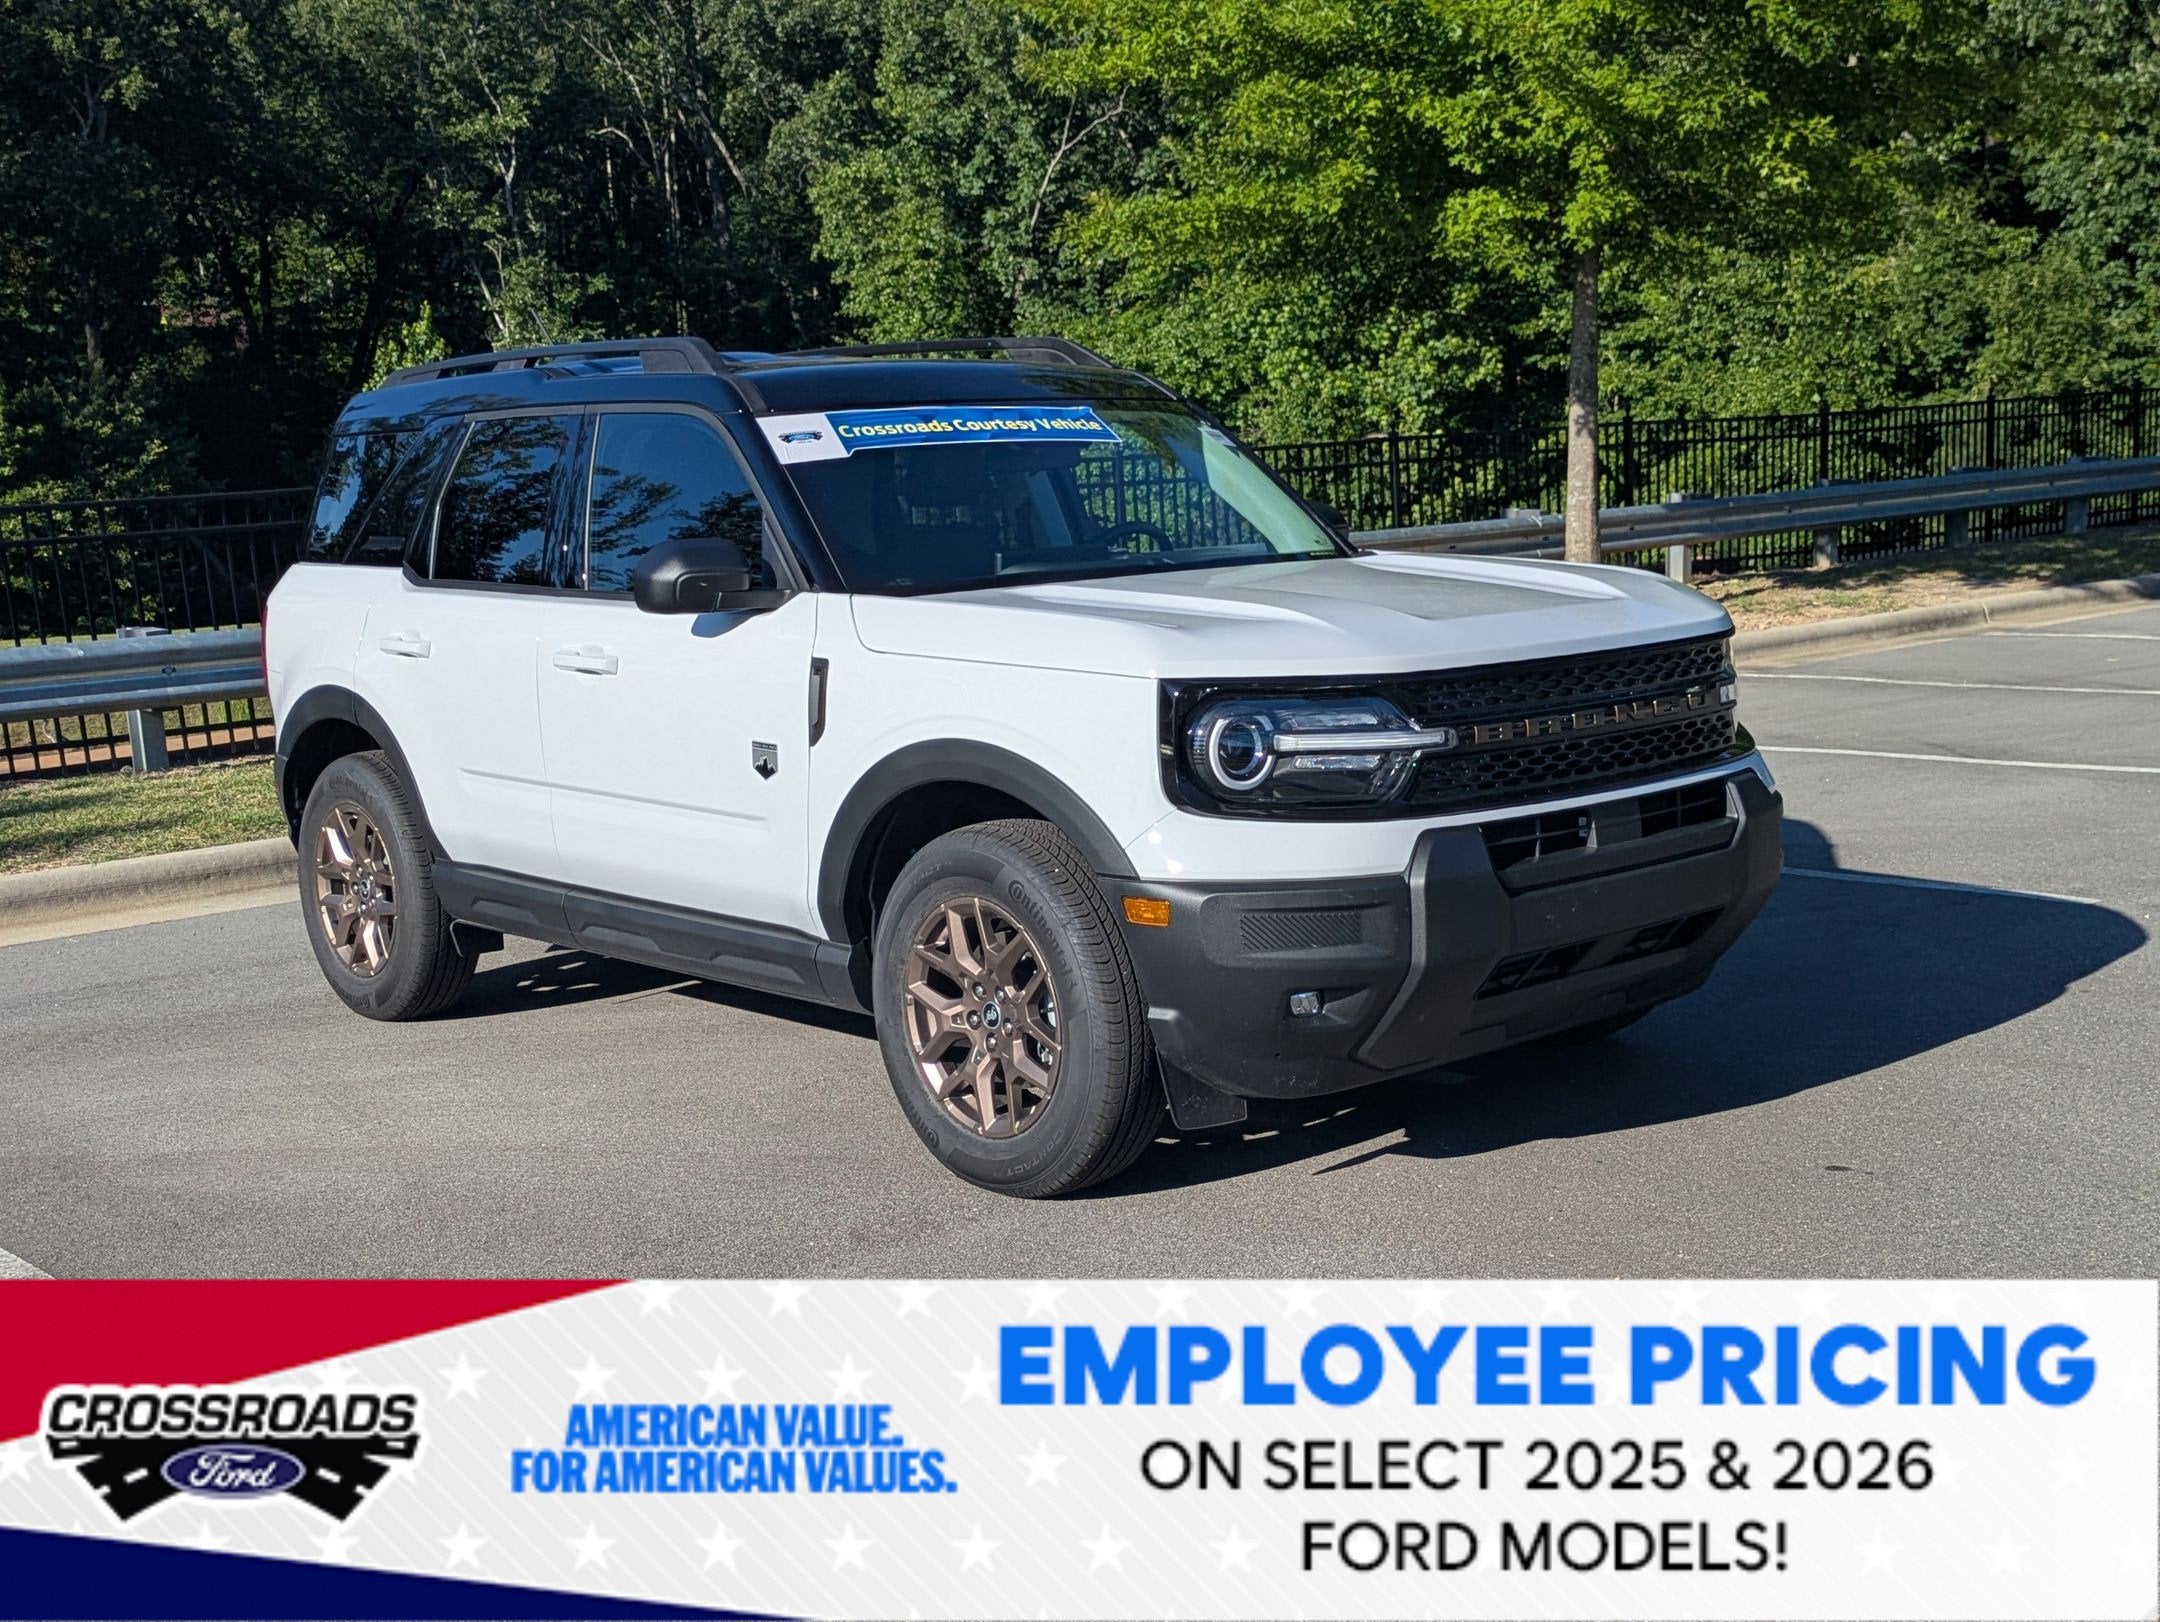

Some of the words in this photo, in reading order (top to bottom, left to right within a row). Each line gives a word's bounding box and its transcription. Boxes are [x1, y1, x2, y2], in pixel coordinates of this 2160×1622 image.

[837, 420, 954, 438] Crossroads
[952, 418, 1038, 432] Courtesy
[1034, 417, 1103, 431] Vehicle
[1473, 693, 1713, 745] BRONCO
